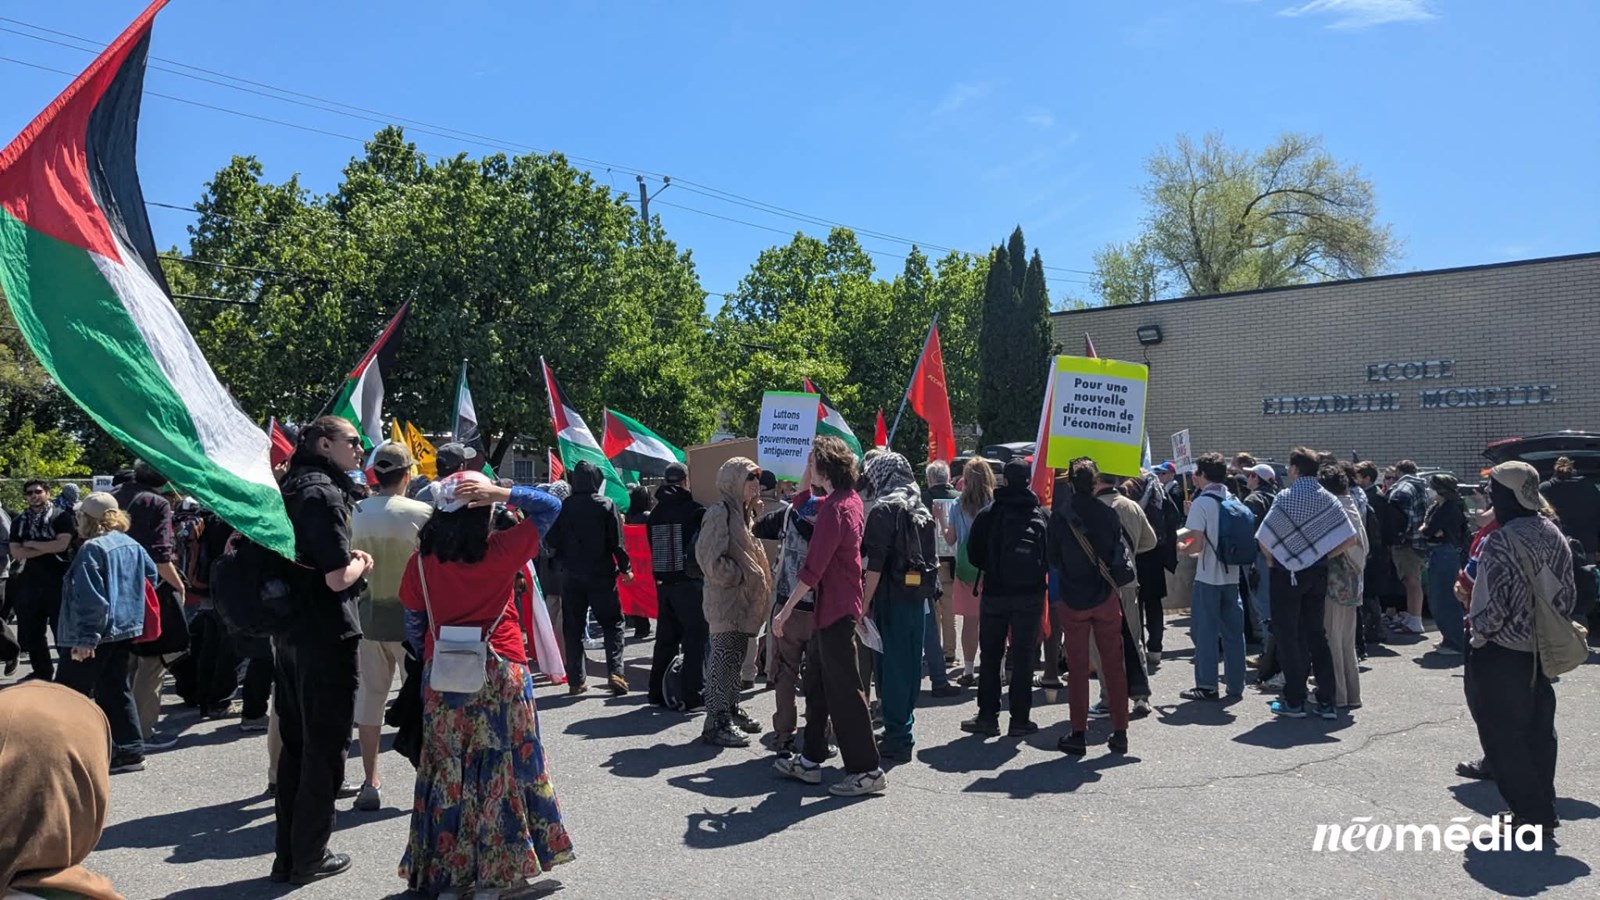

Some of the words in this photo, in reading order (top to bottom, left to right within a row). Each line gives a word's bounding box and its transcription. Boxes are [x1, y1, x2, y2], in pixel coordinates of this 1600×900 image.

[1074, 377, 1103, 390] Pour
[1106, 381, 1128, 394] une
[1074, 393, 1126, 407] nouvelle
[1262, 393, 1398, 415] ELISABETH
[1421, 384, 1556, 408] MONETTE
[773, 409, 800, 420] Luttons
[1062, 403, 1116, 419] direction
[1119, 409, 1135, 422] de
[772, 422, 787, 432] pour
[788, 423, 799, 432] un
[1062, 415, 1132, 435] l'économie!
[759, 435, 810, 446] gouvernement
[763, 445, 803, 458] antiguerre!
